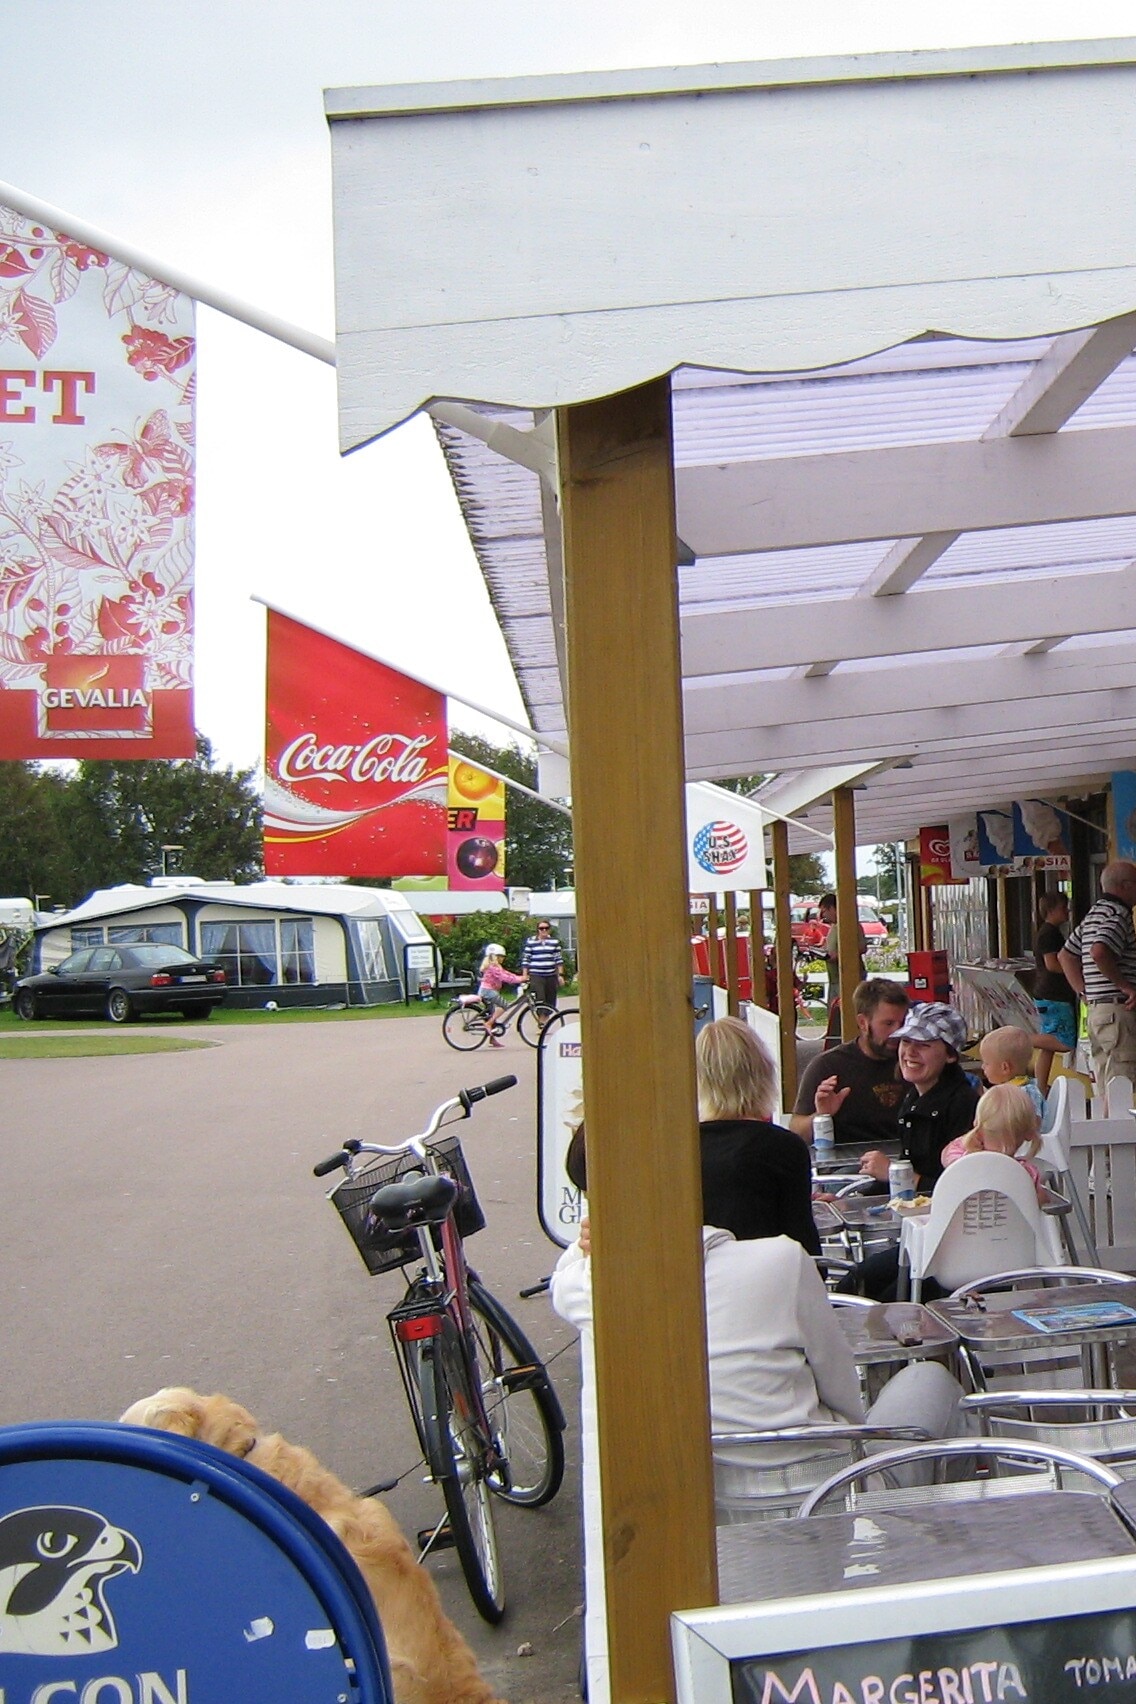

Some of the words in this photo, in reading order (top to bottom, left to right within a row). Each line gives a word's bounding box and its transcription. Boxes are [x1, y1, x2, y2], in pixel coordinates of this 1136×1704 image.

[42, 687, 149, 709] GEVALIA
[278, 733, 437, 783] Coca-Cola
[1045, 857, 1069, 866] SIA
